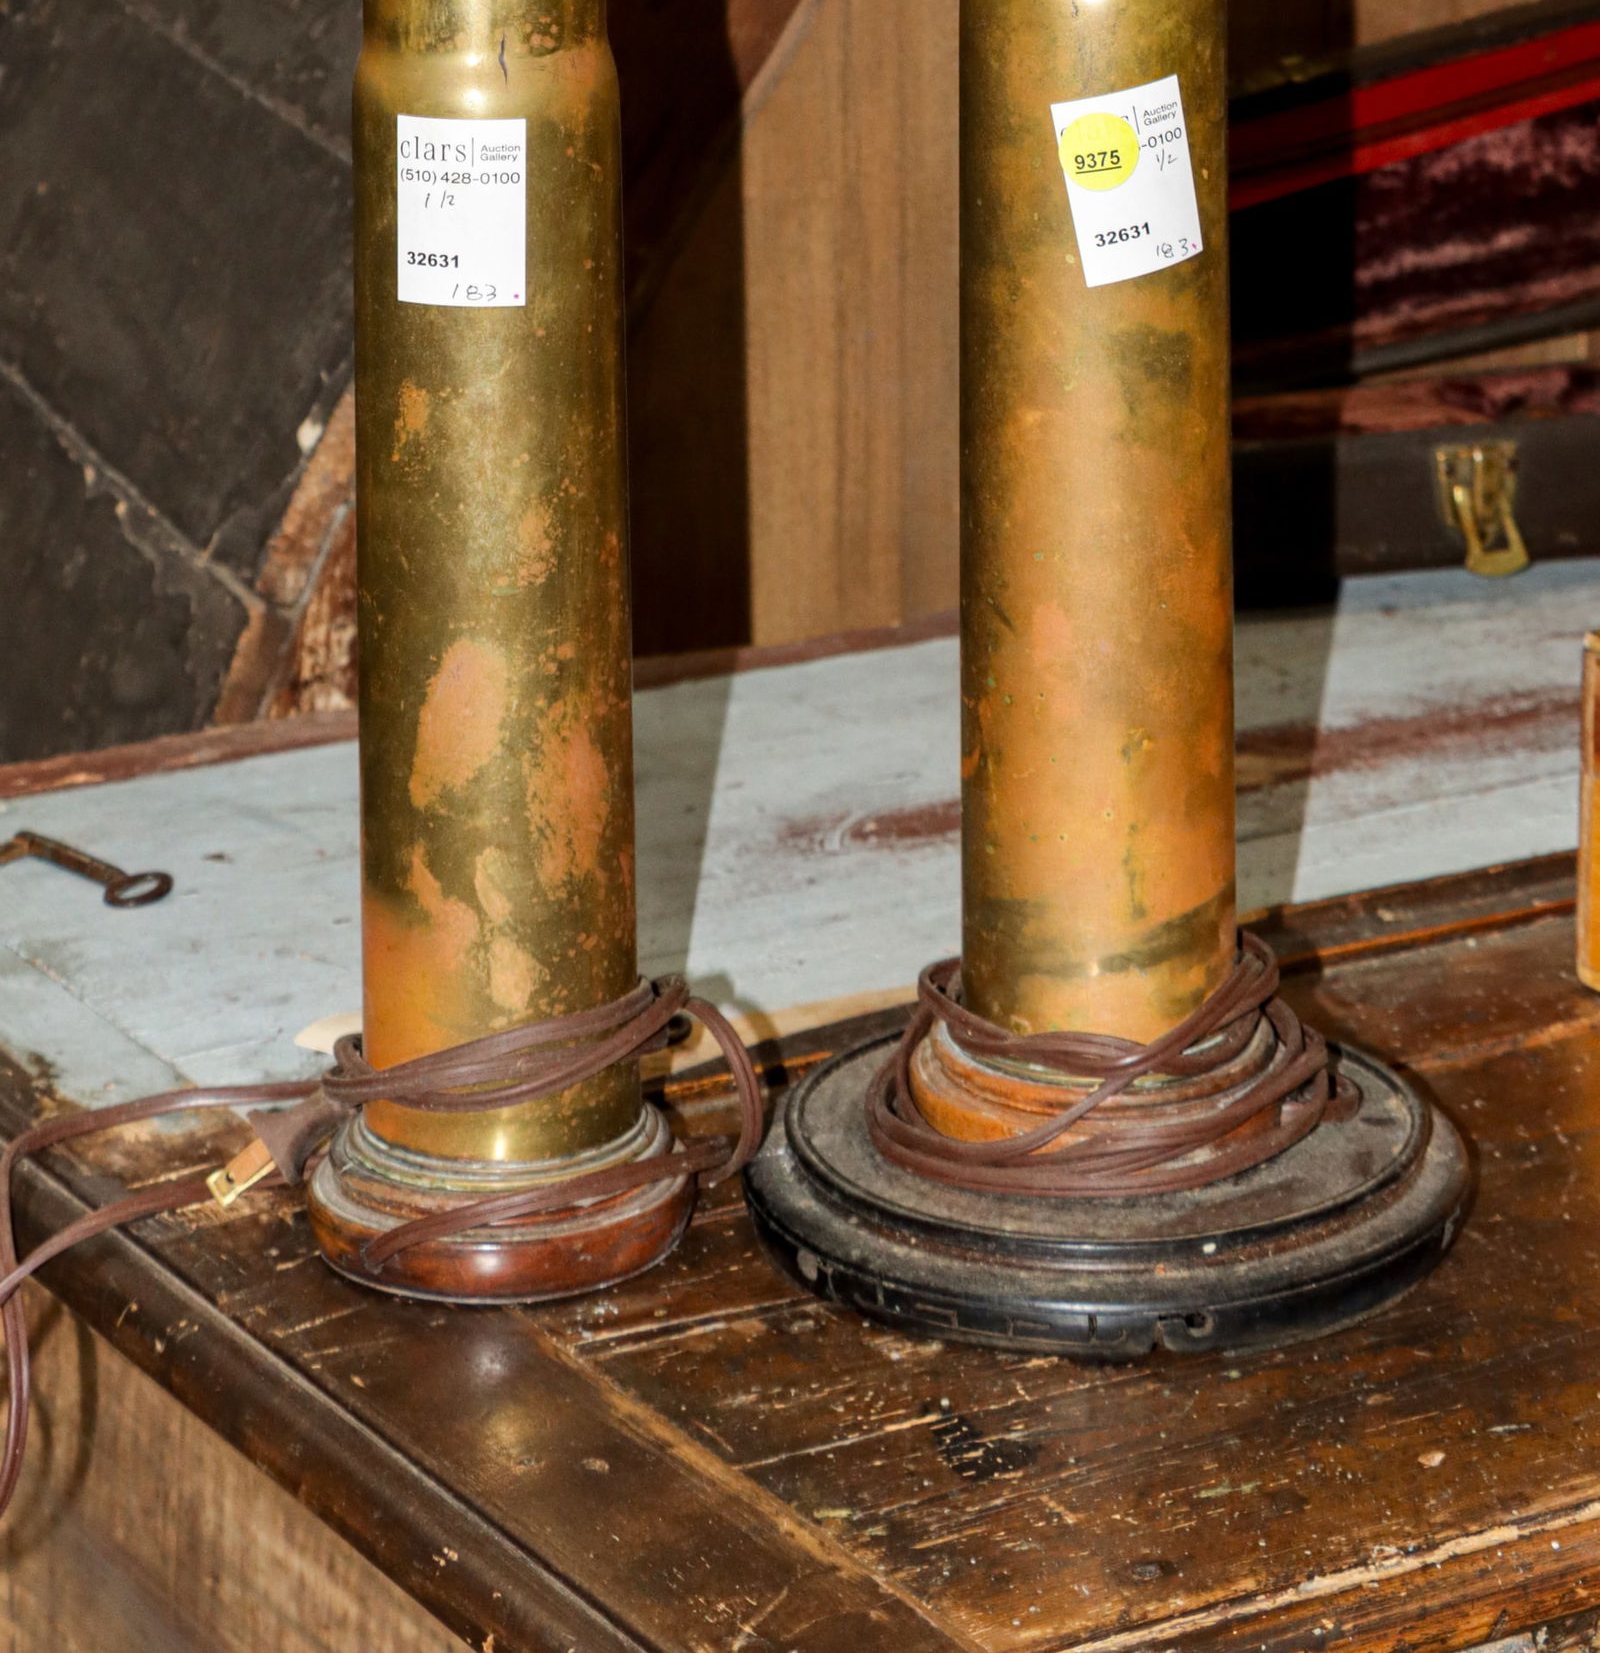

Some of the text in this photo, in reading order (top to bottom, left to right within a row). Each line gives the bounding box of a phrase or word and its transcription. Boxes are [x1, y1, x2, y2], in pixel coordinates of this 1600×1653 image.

[1143, 101, 1178, 118] Auction
[1143, 110, 1177, 127] Gallery
[1139, 127, 1182, 150] -0100
[400, 136, 467, 163] clars
[480, 144, 521, 153] Auction
[480, 153, 518, 163] Gallery
[1074, 149, 1121, 170] 9375
[400, 168, 521, 185] (510) 428-0100
[1094, 221, 1151, 247] 32631
[406, 251, 459, 268] 32631
